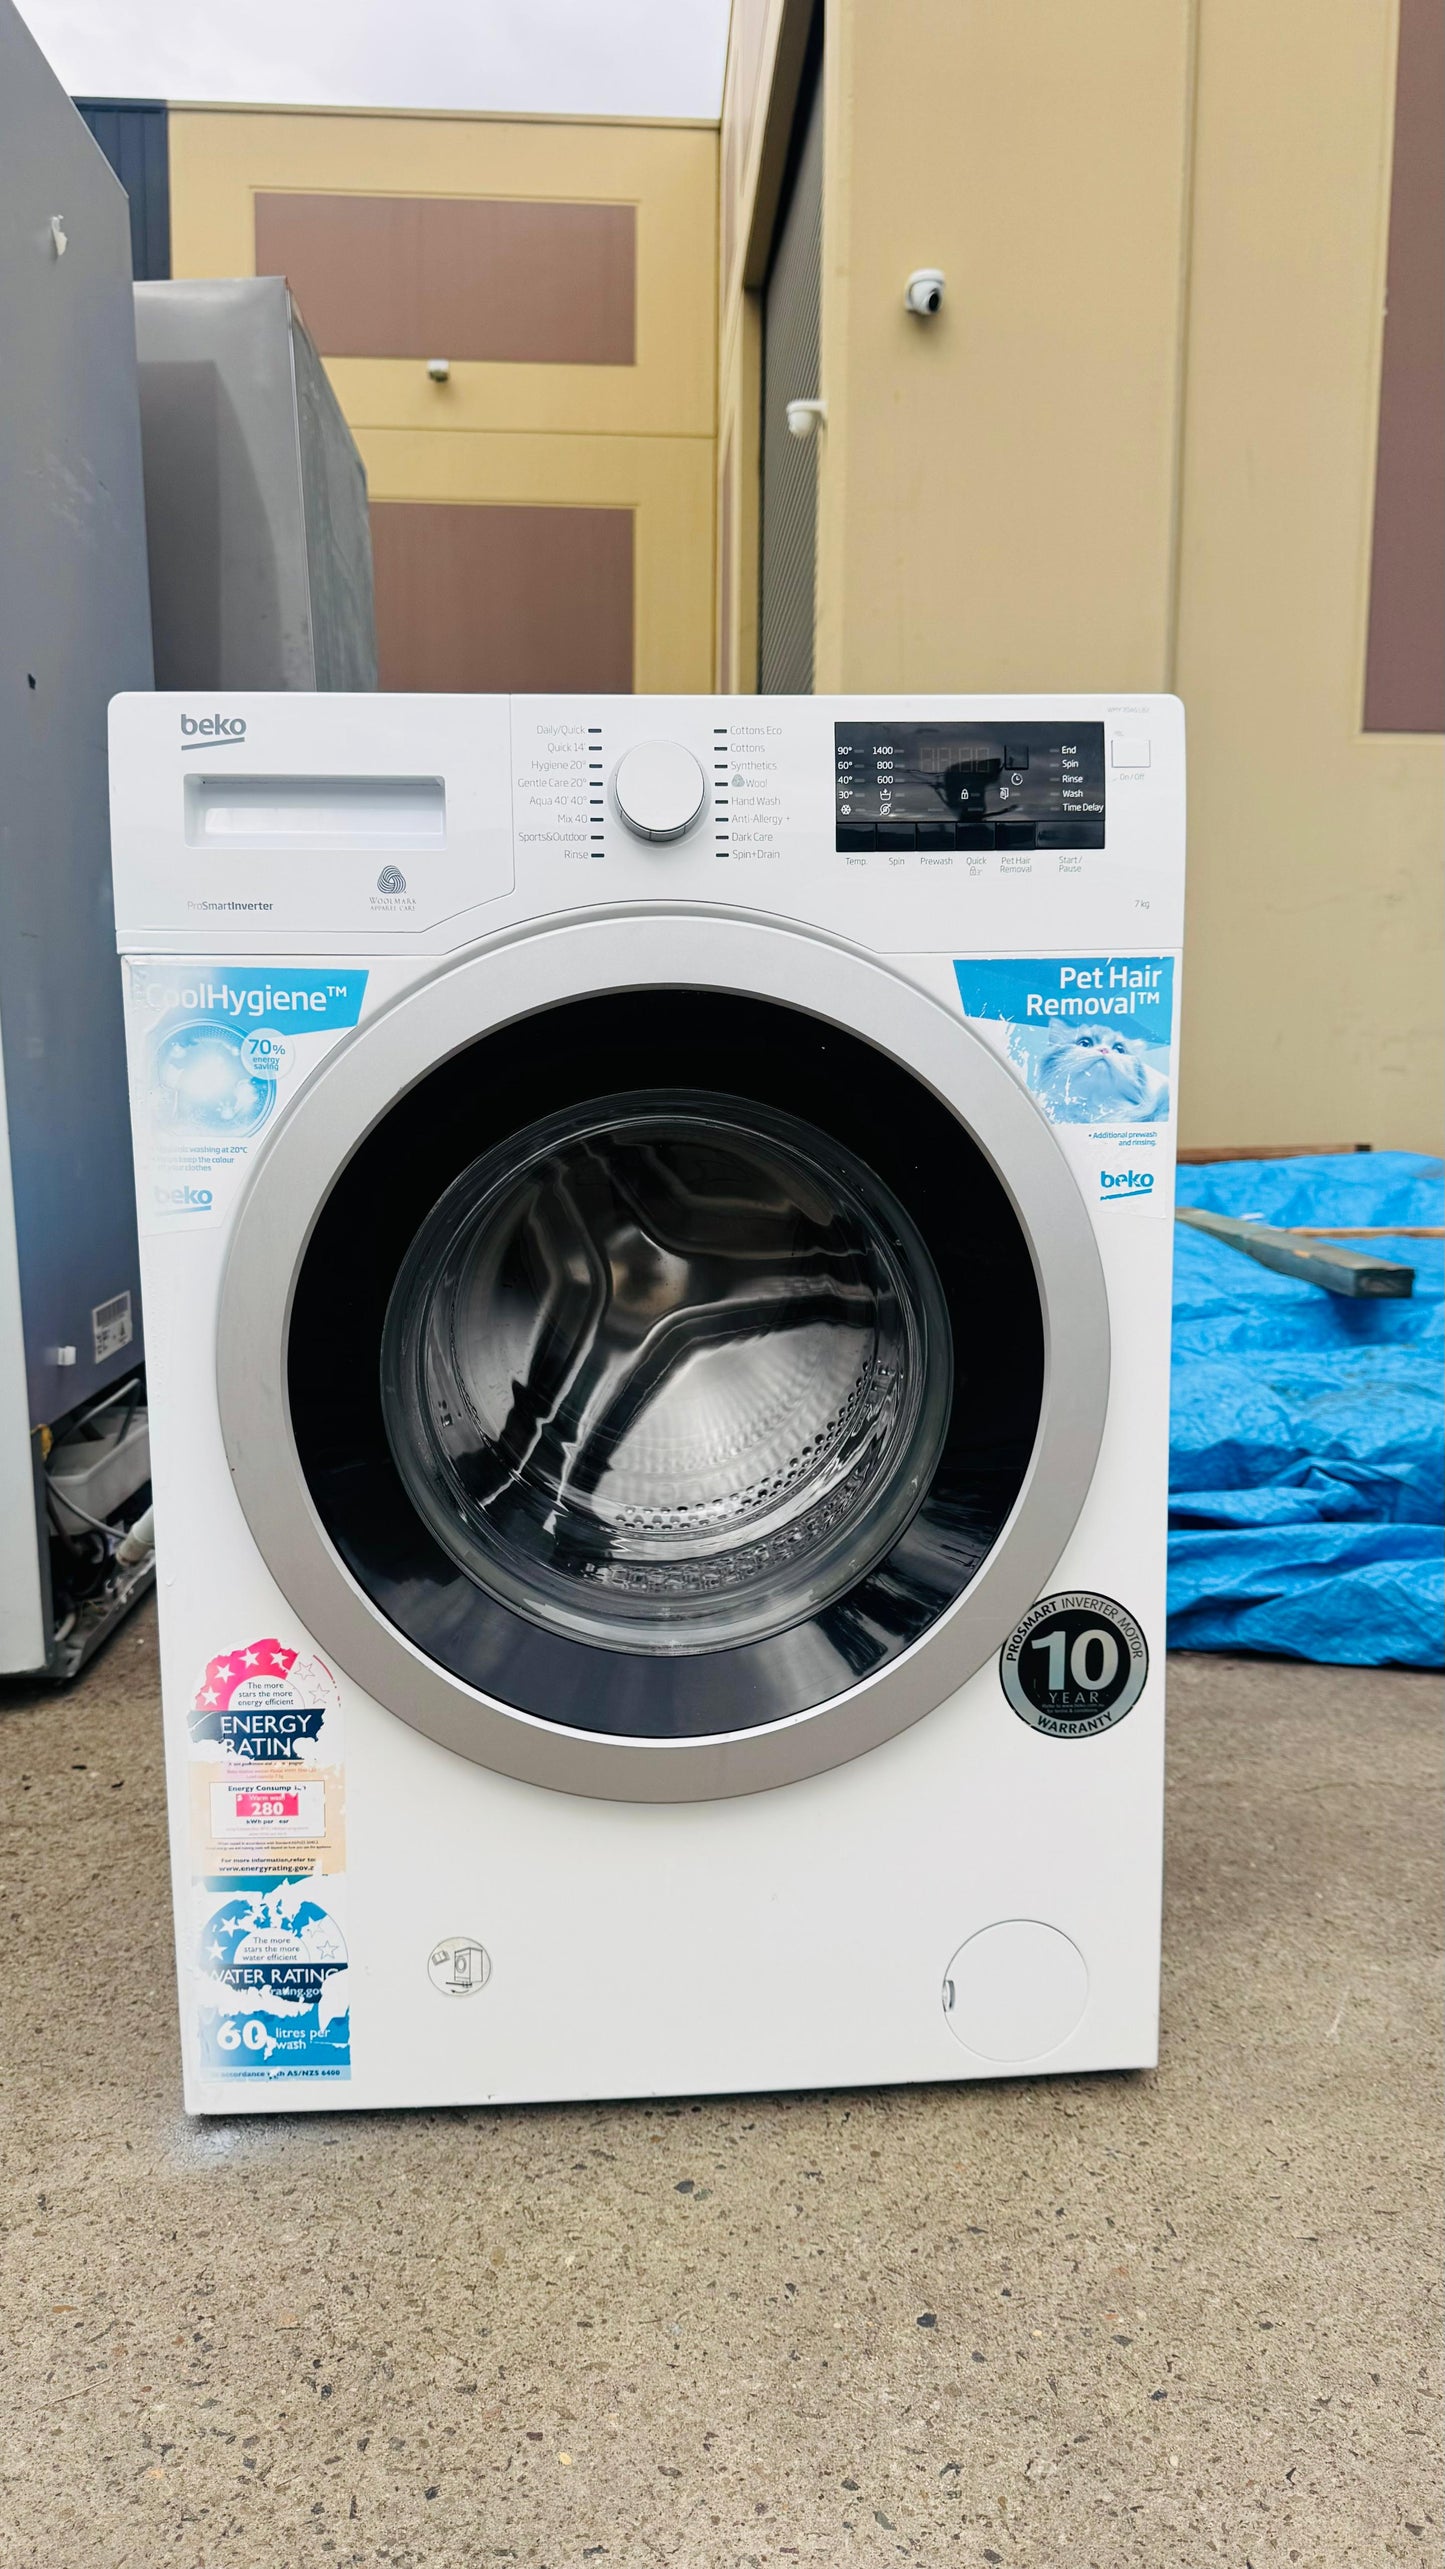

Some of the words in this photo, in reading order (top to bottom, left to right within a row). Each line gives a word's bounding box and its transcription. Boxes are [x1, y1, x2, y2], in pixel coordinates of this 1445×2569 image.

[181, 714, 246, 736] beko
[537, 725, 585, 735] Daily/Quick
[730, 726, 765, 735] Cottons
[767, 726, 782, 735] Eco
[547, 743, 571, 753] Quick
[730, 744, 765, 753] Cottons
[837, 746, 852, 755] 90°
[873, 746, 893, 755] 1400
[1062, 746, 1077, 754] End
[531, 760, 568, 771] Hygiene
[570, 760, 586, 770] 20°
[731, 761, 777, 771] Synthetics
[837, 761, 853, 770] 60°
[877, 761, 893, 770] 800
[1062, 760, 1079, 768] Spin
[838, 776, 853, 784] 40°
[877, 776, 893, 784] 600
[1062, 775, 1083, 783] Rinse
[1134, 773, 1145, 781] Off
[518, 778, 547, 787] Gentle
[548, 778, 568, 787] Care
[745, 779, 767, 788] Wool
[838, 790, 853, 799] 30°
[1063, 790, 1084, 798] Wash
[530, 796, 552, 806] Aqua
[731, 797, 755, 806] Hand
[757, 797, 780, 806] Wash
[1063, 803, 1082, 812] Time
[1082, 803, 1104, 813] Delay
[558, 814, 573, 823] Mix
[731, 814, 783, 825] Anti-Allergy
[519, 832, 587, 842] Sports&Outdoor
[732, 832, 752, 842] Dark
[753, 832, 773, 842] Care
[564, 850, 589, 859] Rinse
[732, 850, 780, 860] Spin+Drain
[889, 857, 905, 866] Spin
[920, 857, 953, 865] Prewash
[966, 857, 987, 865] Quick
[1001, 857, 1015, 865] Pet
[1016, 857, 1031, 865] Hair
[1059, 856, 1077, 864] Start
[1000, 865, 1032, 873] Removal
[369, 897, 416, 905] WOOLMARK
[1135, 900, 1140, 908] 7
[1140, 900, 1150, 909] kg
[187, 901, 273, 911] ProSmartInverter
[1060, 967, 1103, 989] Pet
[1109, 965, 1163, 988] Hair
[250, 1039, 285, 1055] 70%
[253, 1057, 280, 1065] energy
[254, 1063, 279, 1071] saving
[189, 1146, 220, 1154] washing
[230, 1146, 248, 1154] 20°C
[1101, 1170, 1154, 1188] beko
[155, 1185, 213, 1204] beko
[1006, 1601, 1057, 1661] PROSMART
[1061, 1597, 1119, 1619] INVERTER
[1117, 1617, 1143, 1659] MOTOR
[1031, 1629, 1118, 1690] 10
[1049, 1691, 1100, 1703] YEAR
[221, 1714, 312, 1734] ENERGY
[1037, 1711, 1112, 1733] WARRANTY
[225, 1737, 292, 1757] RATIN
[251, 1802, 284, 1816] 280
[209, 1968, 265, 1984] WATER
[217, 2020, 268, 2050] 60
[276, 2028, 306, 2038] litres
[310, 2028, 331, 2042] per
[275, 2040, 306, 2050] wash
